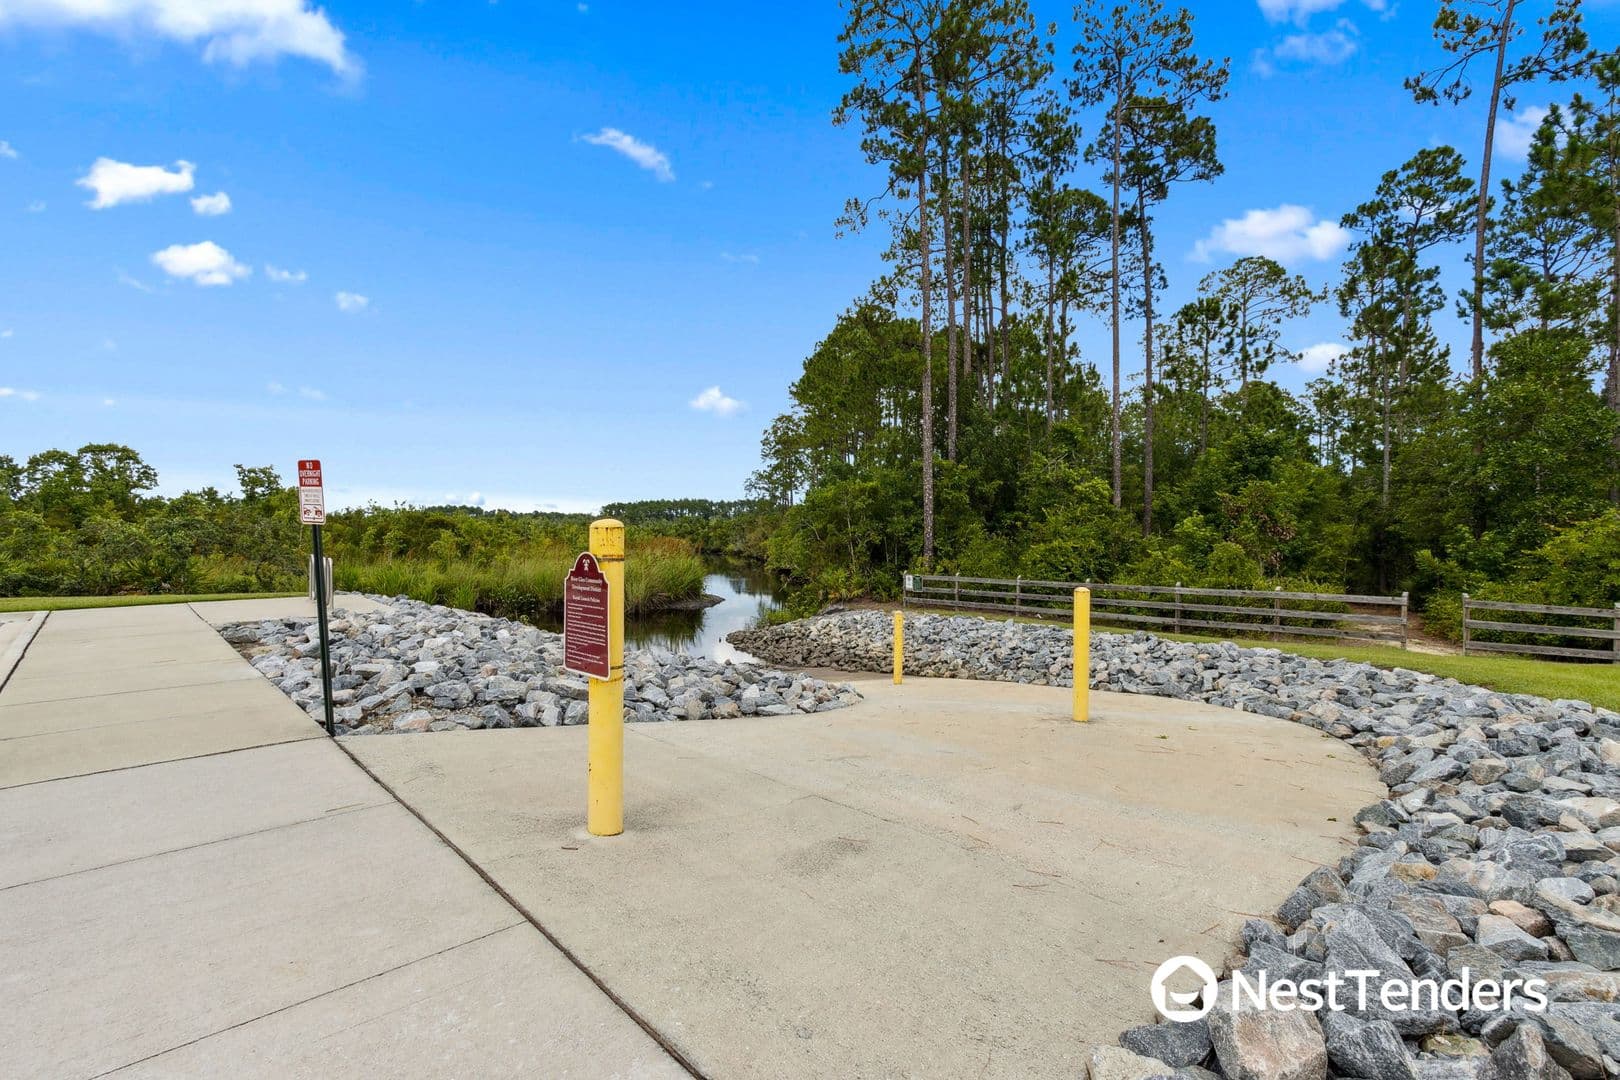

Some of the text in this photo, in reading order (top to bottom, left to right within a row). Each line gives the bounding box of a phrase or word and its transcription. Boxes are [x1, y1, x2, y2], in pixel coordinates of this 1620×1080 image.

[305, 461, 313, 470] NO
[300, 470, 320, 478] OVERNIGHT
[302, 477, 320, 486] PARKING
